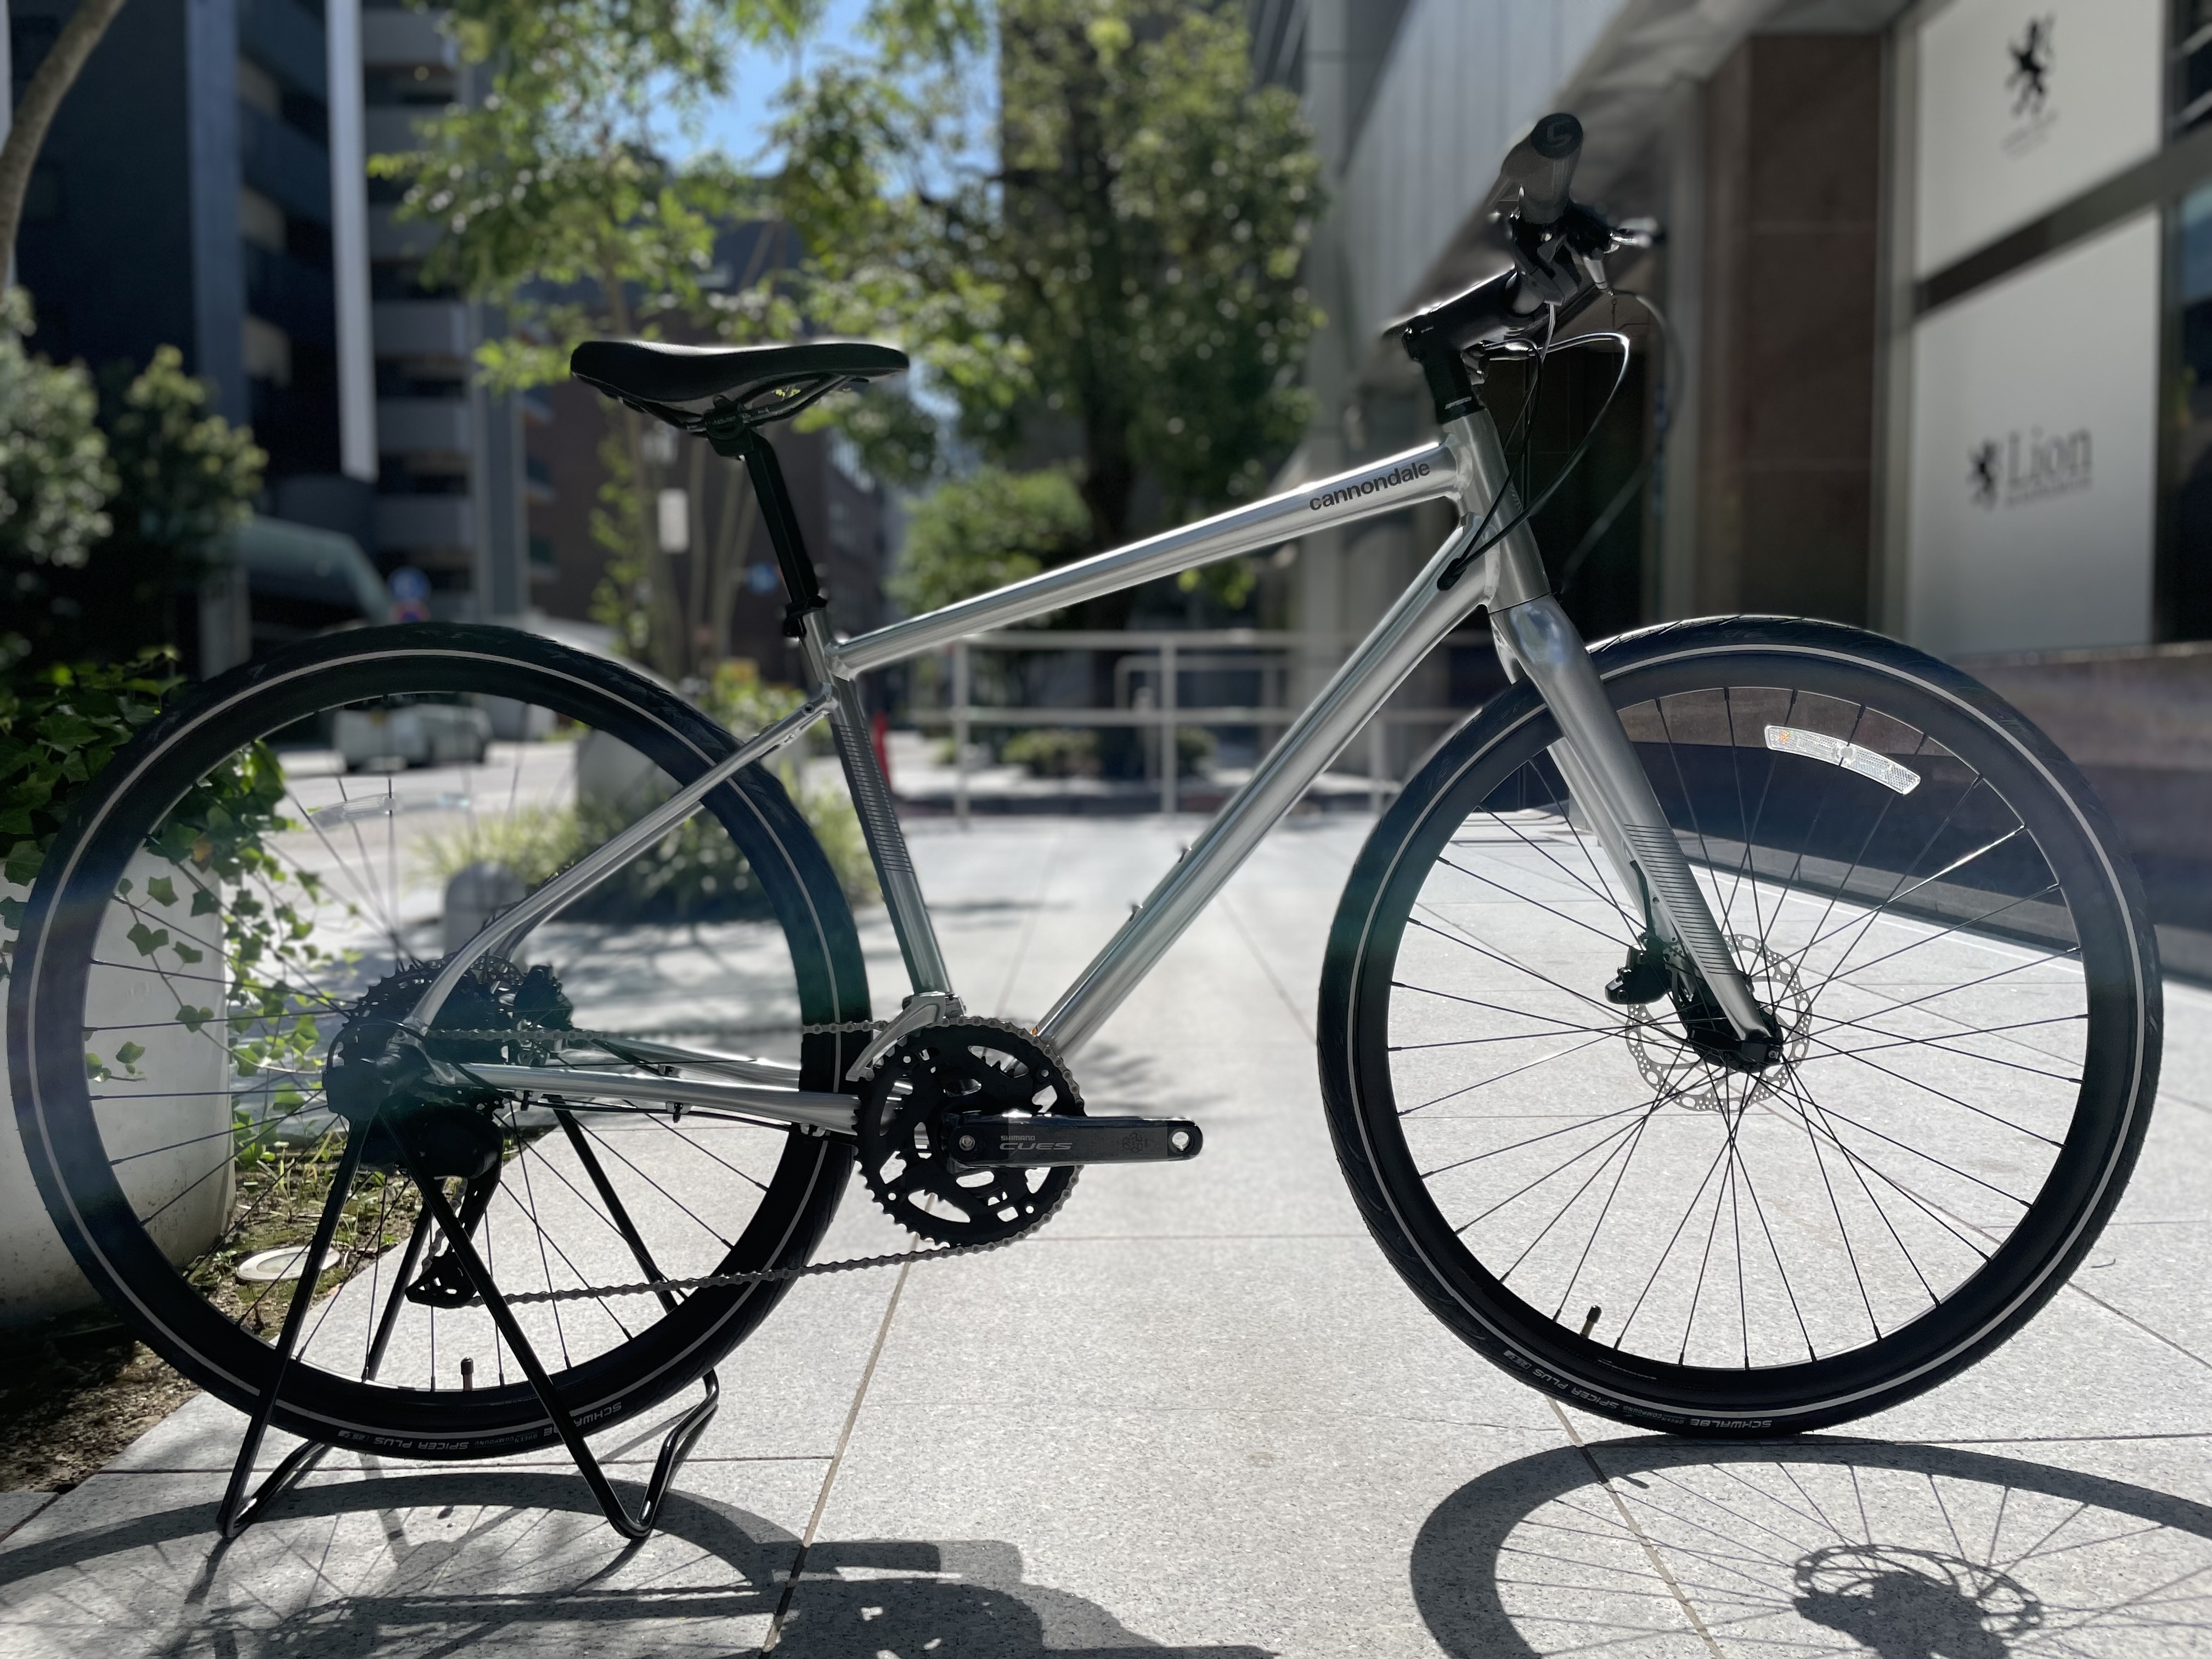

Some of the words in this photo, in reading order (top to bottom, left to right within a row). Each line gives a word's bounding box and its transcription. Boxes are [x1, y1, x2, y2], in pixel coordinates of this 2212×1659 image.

[2008, 425, 2092, 488] Lion
[1310, 463, 1431, 511] cannondale
[999, 1142, 1073, 1151] CUES
[1532, 1368, 1568, 1390] PLUS
[1571, 1387, 1619, 1410] SPICER
[1623, 1406, 1663, 1419] COMPOUND
[1690, 1418, 1773, 1429] SCHWALBE
[373, 1436, 413, 1448] PLUS
[418, 1441, 470, 1450] SPICER
